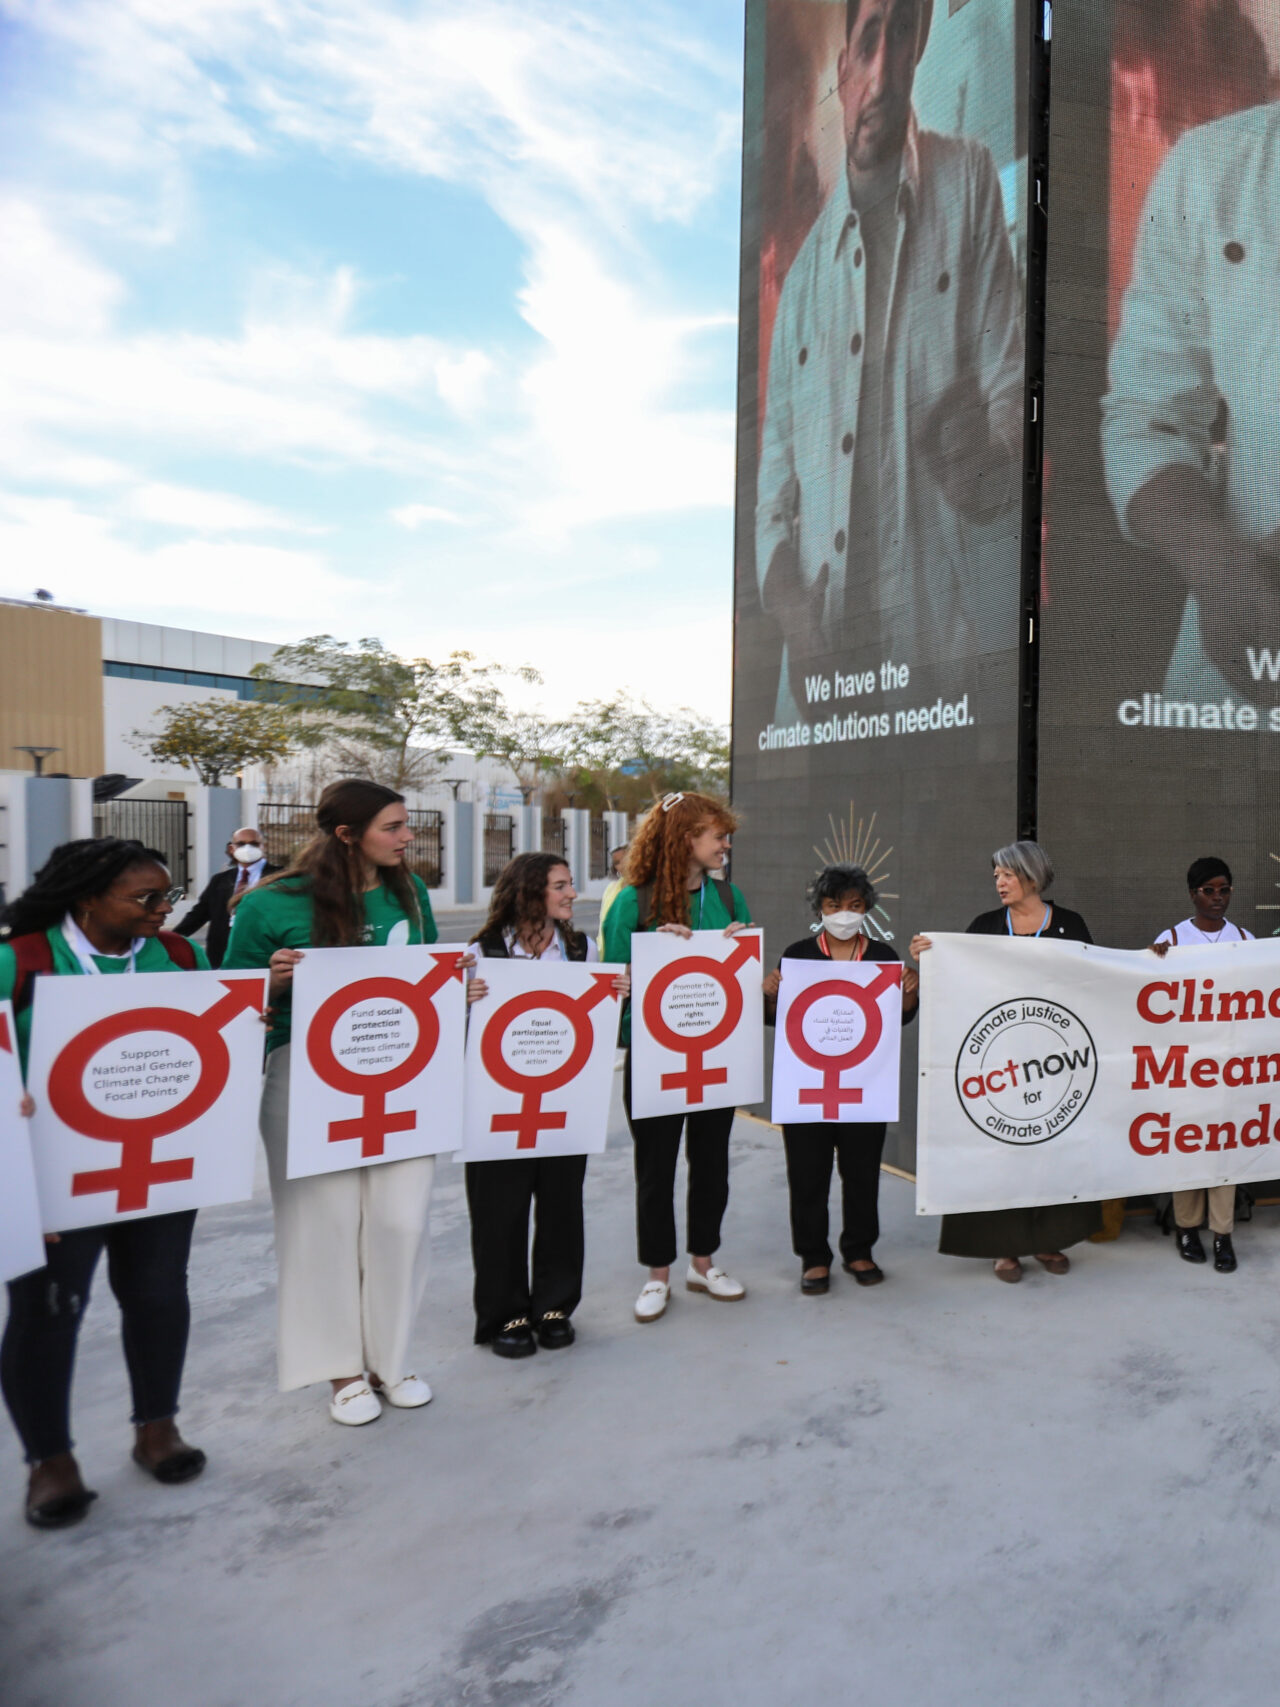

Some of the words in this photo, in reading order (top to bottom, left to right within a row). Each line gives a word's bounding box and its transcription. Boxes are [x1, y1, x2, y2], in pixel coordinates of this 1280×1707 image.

[805, 675, 830, 703] We
[835, 670, 875, 699] have
[880, 660, 909, 691] the
[1118, 693, 1258, 730] climate
[759, 722, 810, 751] climate
[814, 711, 890, 744] solutions
[895, 693, 974, 734] needed.
[352, 1009, 374, 1018] Fund
[377, 1007, 402, 1016] social
[352, 1020, 399, 1031] protection
[678, 1020, 710, 1028] defenders
[969, 1008, 1016, 1054] climate
[1022, 1003, 1070, 1029] justice
[352, 1033, 388, 1042] systems
[121, 1049, 170, 1060] Support
[339, 1046, 375, 1055] address
[378, 1042, 410, 1051] climate
[357, 1056, 393, 1065] impacts
[92, 1063, 146, 1075] National
[150, 1060, 194, 1070] Gender
[94, 1078, 141, 1089] Climate
[146, 1074, 190, 1083] Change
[105, 1090, 137, 1101] Focal
[141, 1088, 178, 1098] Points
[1024, 1091, 1042, 1105] for
[986, 1116, 1042, 1137] climate
[1045, 1089, 1082, 1134] justice
